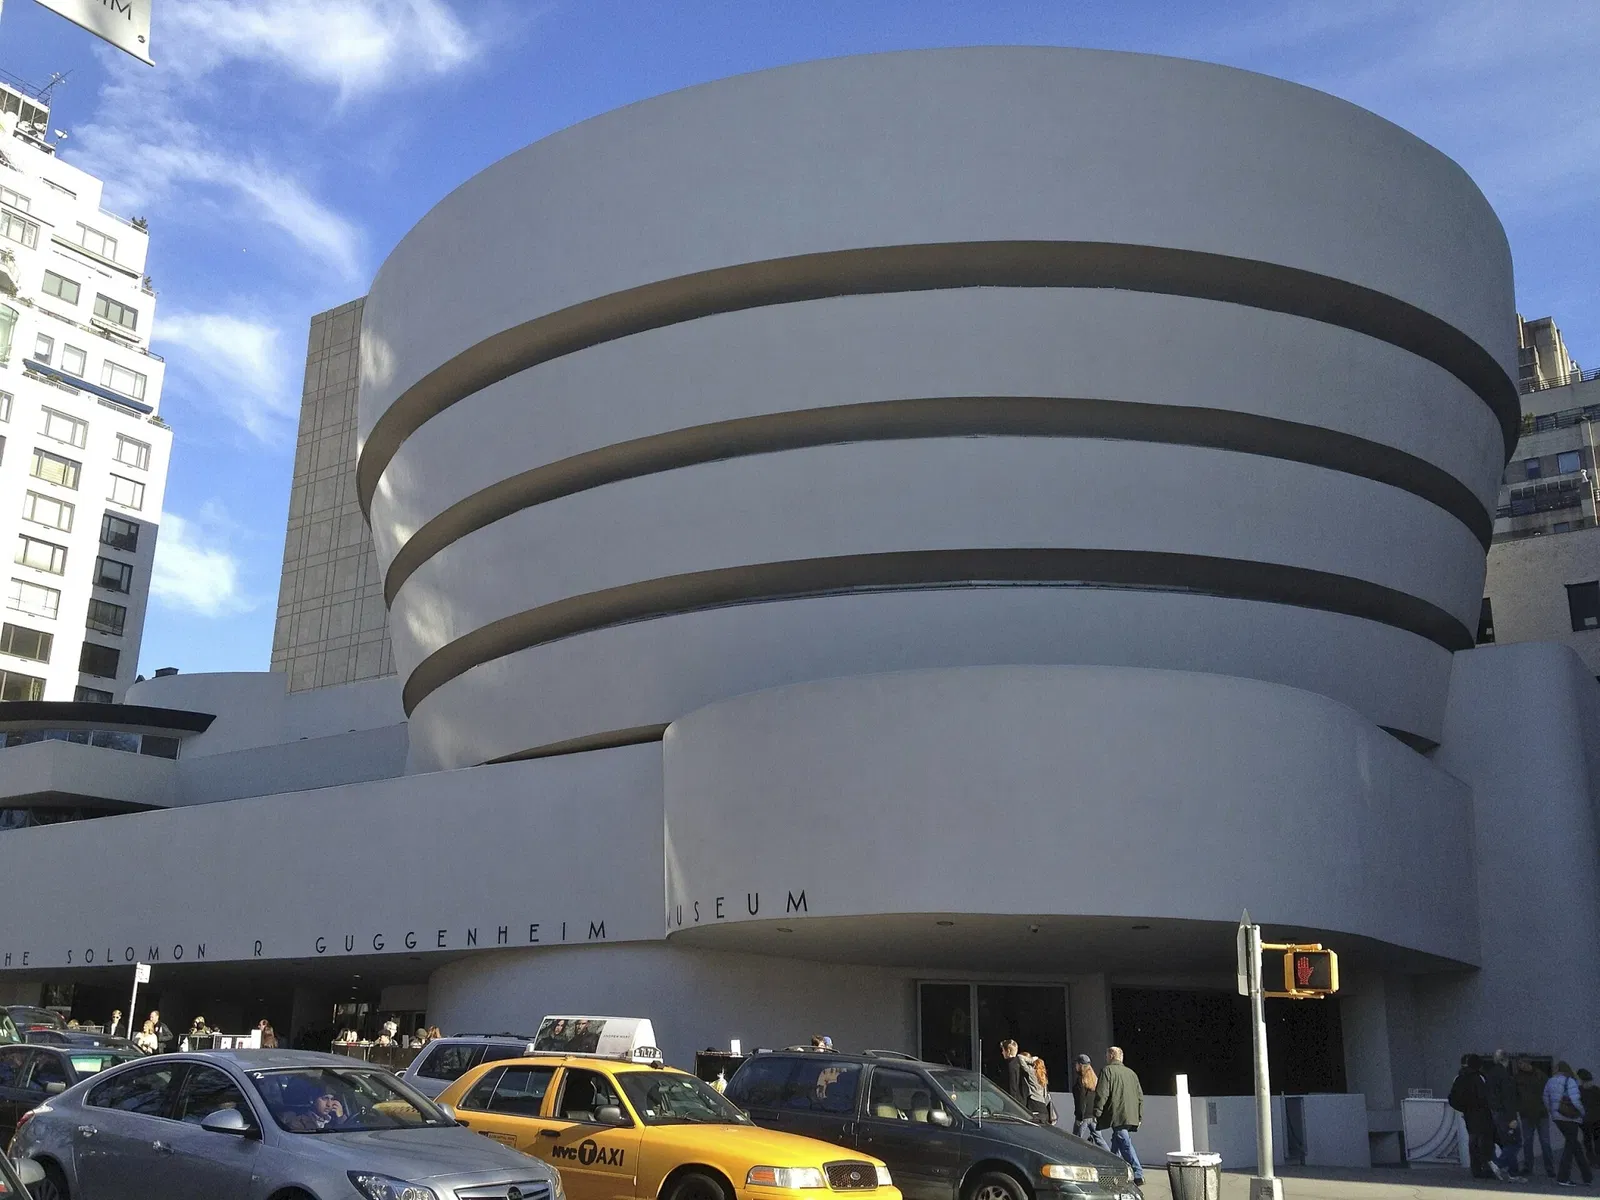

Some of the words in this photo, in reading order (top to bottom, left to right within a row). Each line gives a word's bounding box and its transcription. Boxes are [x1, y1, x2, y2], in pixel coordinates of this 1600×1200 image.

[5, 951, 30, 967] HE
[67, 943, 206, 964] SOLOMON
[254, 940, 262, 957] R
[315, 920, 606, 954] GUGGENHEIM
[552, 1145, 577, 1160] NYC
[578, 1139, 625, 1167] TAXI
